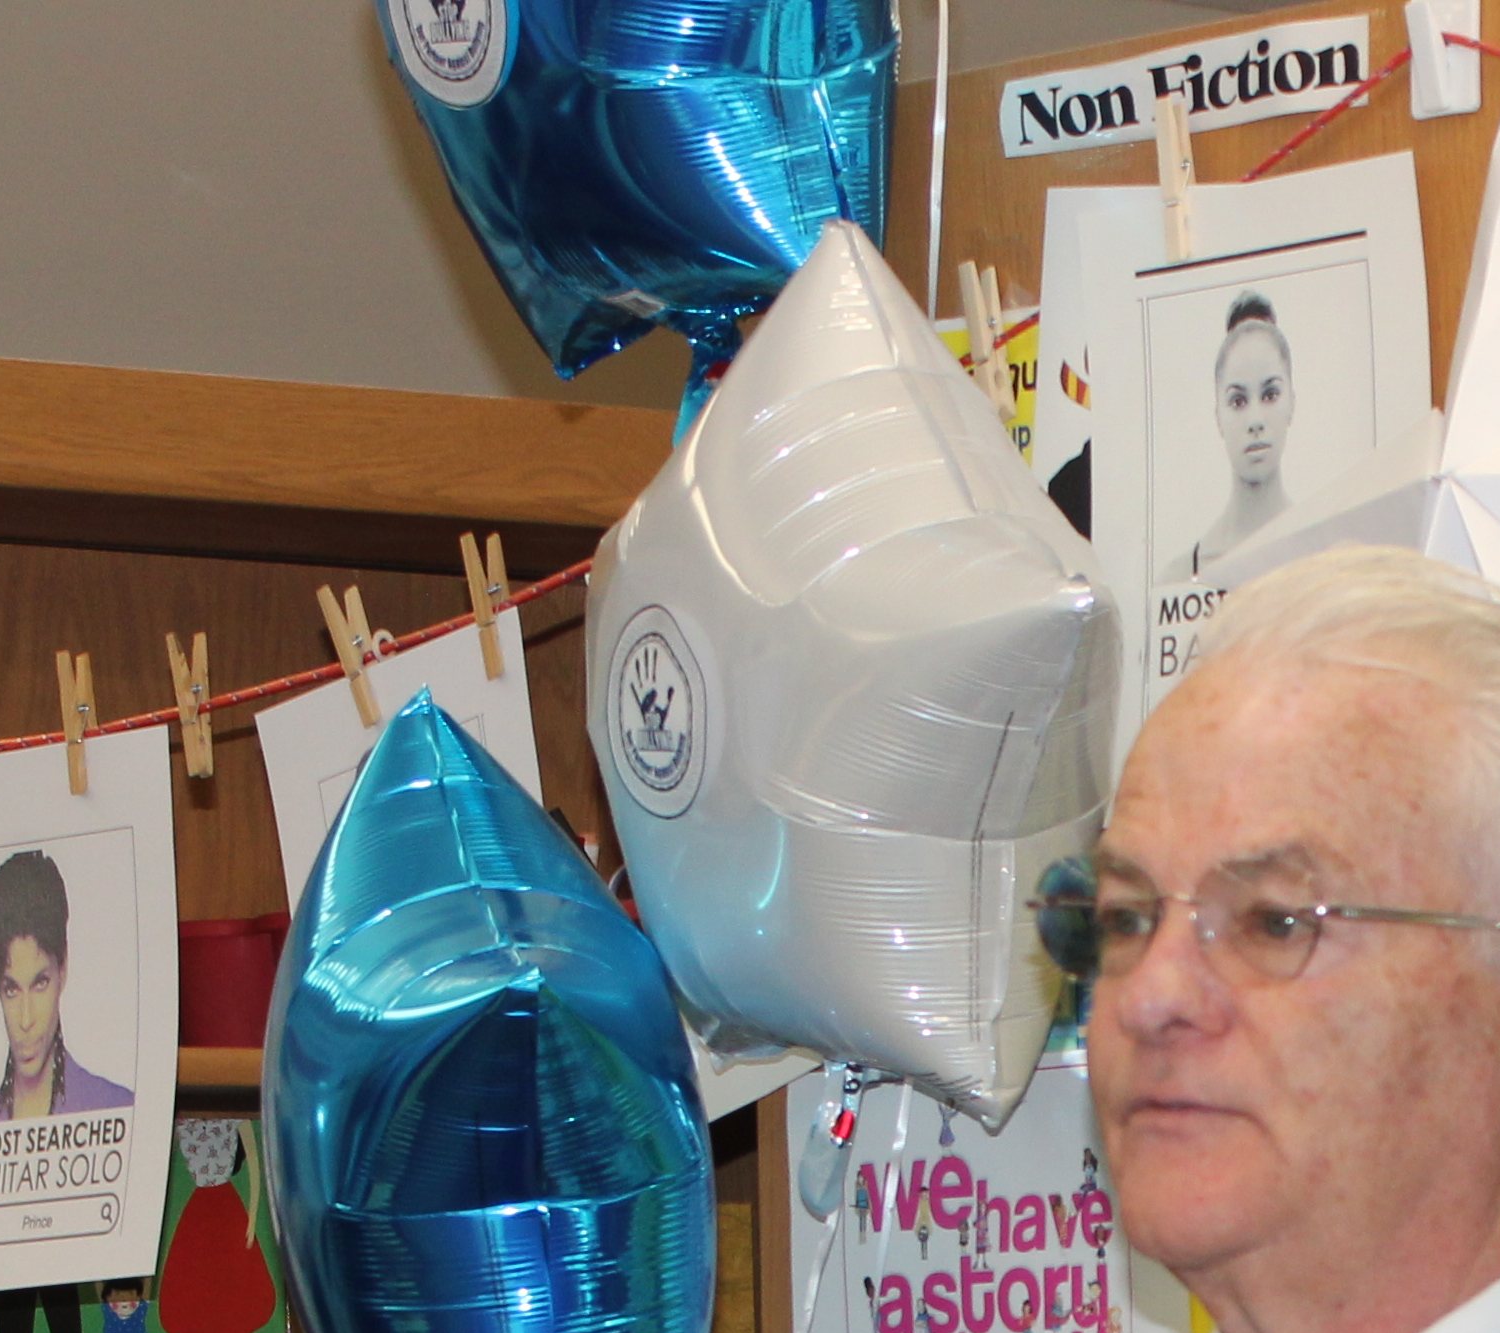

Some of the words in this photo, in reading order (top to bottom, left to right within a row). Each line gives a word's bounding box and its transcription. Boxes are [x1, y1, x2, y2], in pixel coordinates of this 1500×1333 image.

[1018, 80, 1137, 146] Non
[1148, 40, 1362, 123] Fiction
[26, 1118, 126, 1154] SEARCHED
[54, 1149, 123, 1188] SOLO
[22, 1214, 53, 1231] Prince
[859, 1155, 973, 1233] we
[975, 1180, 1114, 1253] have
